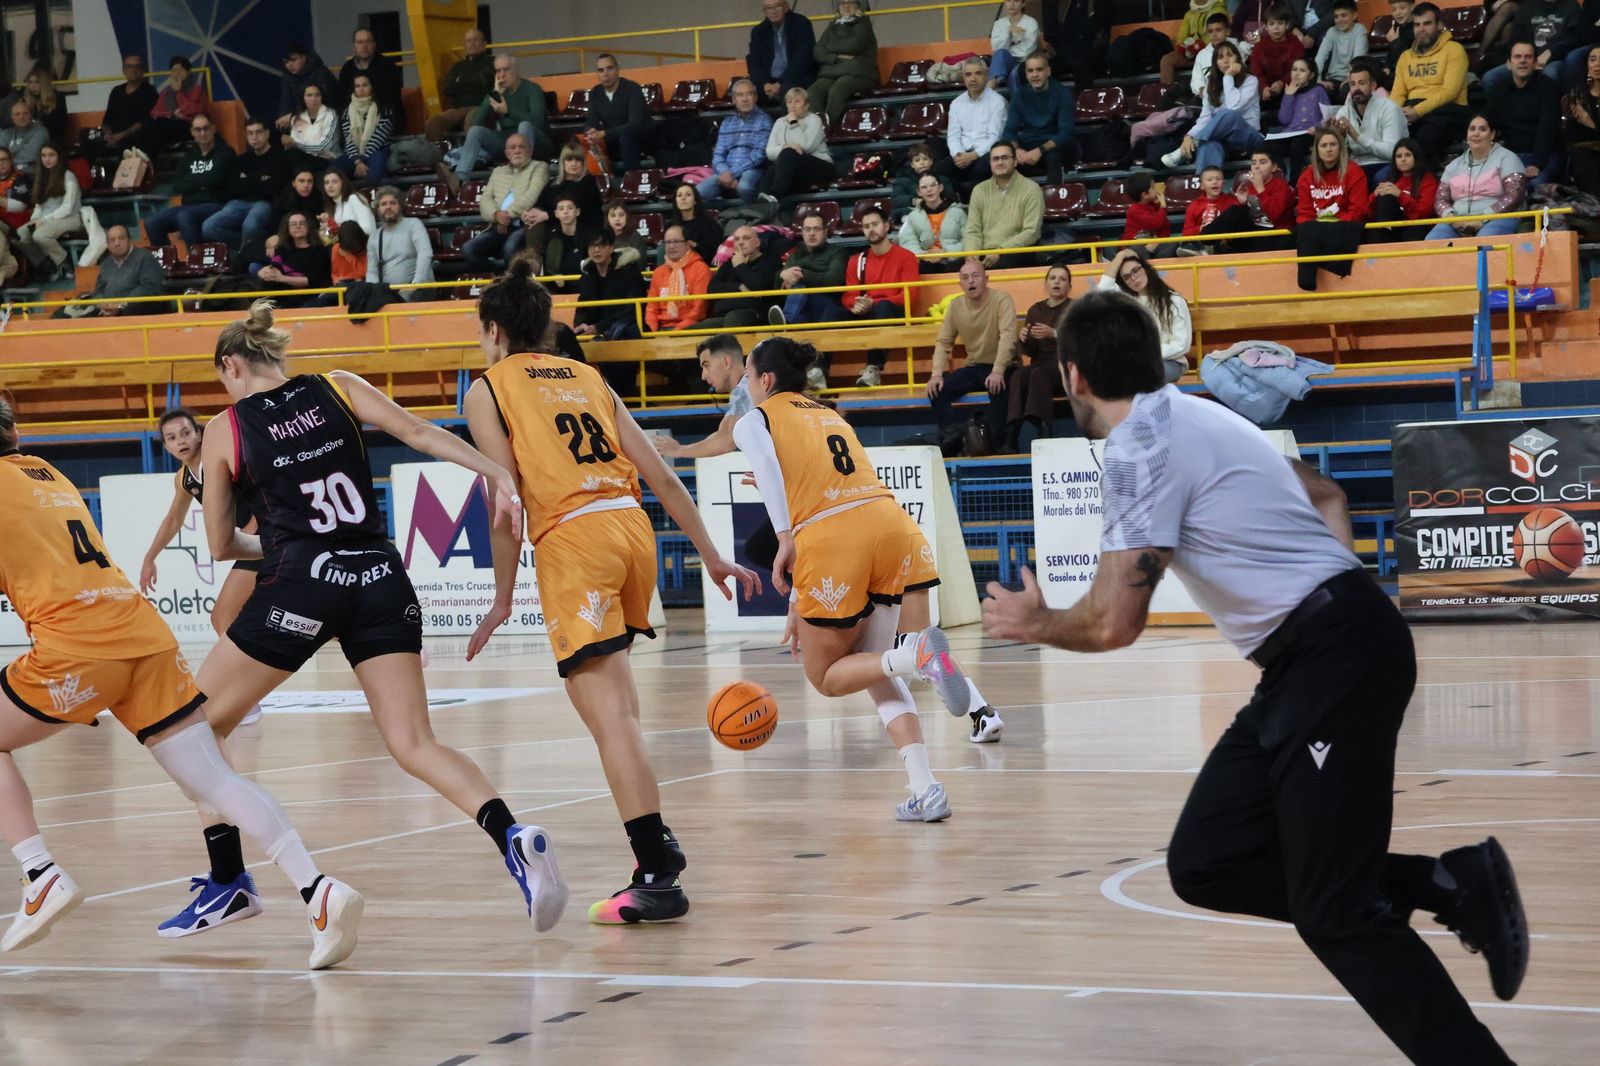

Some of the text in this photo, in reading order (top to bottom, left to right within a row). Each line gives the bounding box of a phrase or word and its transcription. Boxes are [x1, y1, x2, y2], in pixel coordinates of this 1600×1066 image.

[1457, 11, 1470, 20] 17
[1408, 62, 1438, 78] VANS
[689, 84, 701, 93] 10
[1097, 91, 1107, 104] 7
[640, 173, 649, 184] 8
[525, 366, 577, 380] SÁNCHEZ
[554, 411, 618, 465] 28
[826, 434, 856, 476] 8
[1509, 446, 1559, 479] DC
[876, 465, 922, 490] FELIPE
[1042, 470, 1099, 485] E.S. CAMINO
[1042, 486, 1099, 500] Tfno.: 980 570
[1408, 482, 1600, 509] DORCOLCH
[299, 471, 367, 534] 30
[1043, 503, 1073, 517] Morales
[1074, 502, 1087, 516] del
[65, 519, 112, 569] 4
[1416, 525, 1514, 558] COMPITE
[1046, 553, 1090, 567] SERVICIO
[1418, 555, 1514, 570] SIN MIEDOS
[1048, 572, 1077, 583] Gasóleo
[1078, 571, 1088, 582] de
[413, 580, 496, 592] venida Tres Cruces
[1420, 593, 1599, 607] TENEMOS LOS MEJORES EQUIPOS
[172, 623, 212, 633] IENEST
[431, 613, 454, 628] 980
[456, 613, 473, 627] 05
[475, 613, 488, 627] 8
[520, 613, 544, 627] 605
